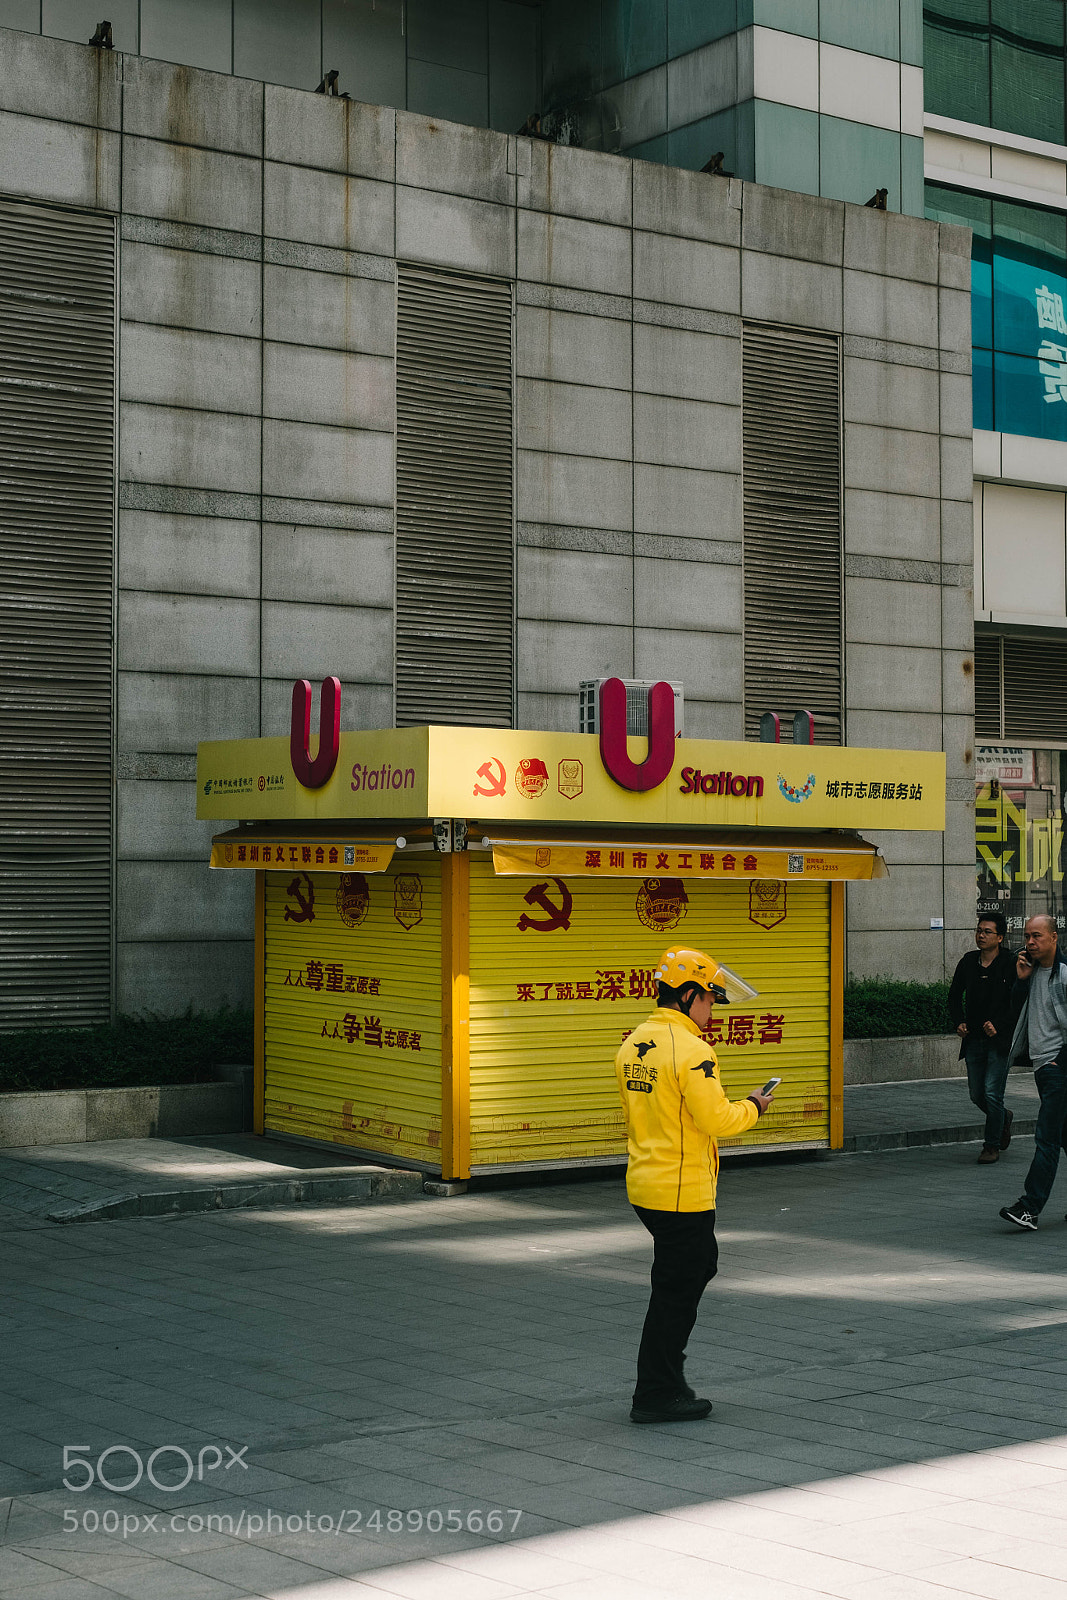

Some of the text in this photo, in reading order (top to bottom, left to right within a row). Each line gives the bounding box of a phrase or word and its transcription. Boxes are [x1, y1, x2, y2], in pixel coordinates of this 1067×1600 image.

[290, 676, 416, 792] U Station
[599, 677, 765, 798] U Station
[825, 780, 923, 801] 城市志愿服务站
[238, 845, 339, 864] 深圳市义工联合会
[585, 850, 758, 871] 深圳市义工联合会
[284, 960, 381, 996] 人人尊重志愿者
[321, 1013, 421, 1051] 人人争当志愿者
[623, 1063, 658, 1082] 美团外卖
